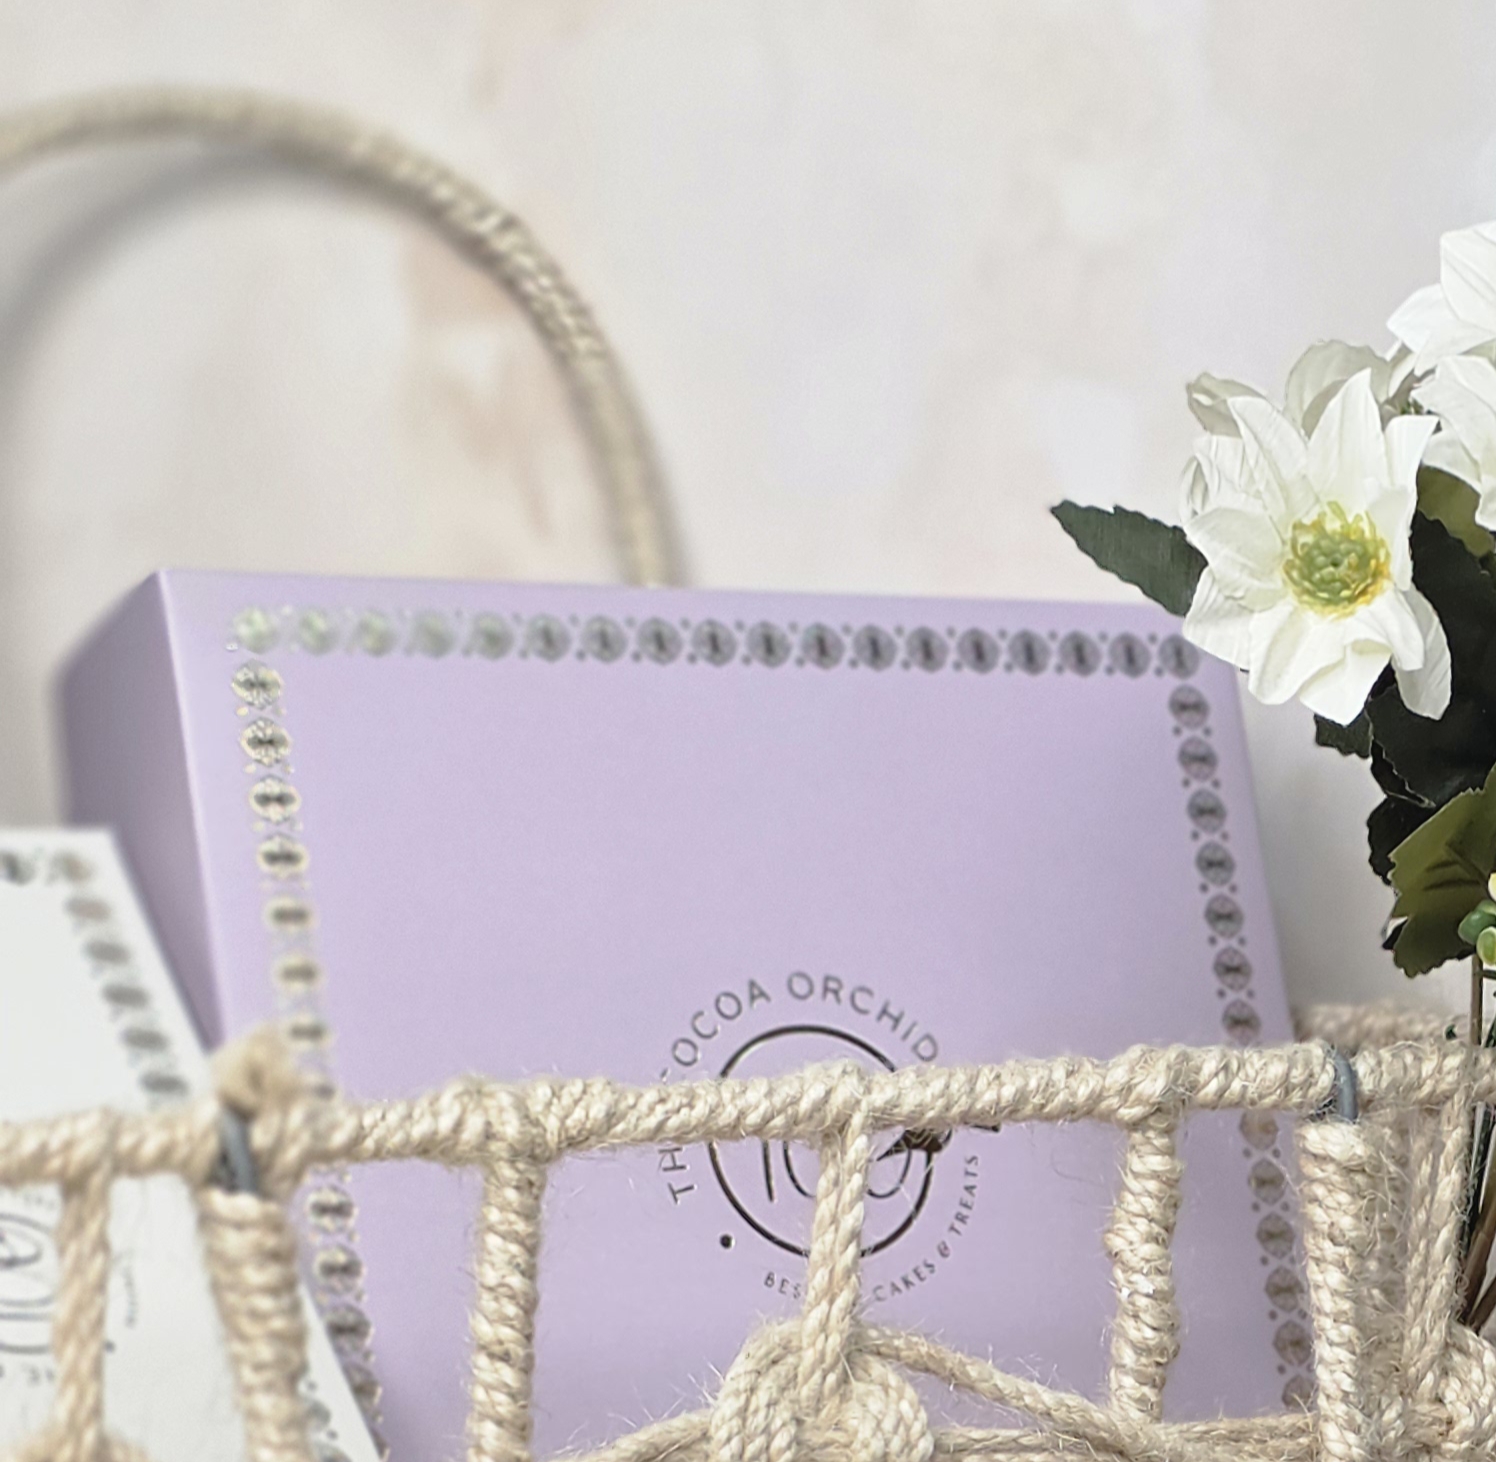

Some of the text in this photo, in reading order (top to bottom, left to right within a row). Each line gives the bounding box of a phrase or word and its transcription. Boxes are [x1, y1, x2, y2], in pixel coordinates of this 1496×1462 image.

[660, 978, 772, 1081] OCOA
[786, 972, 939, 1063] ORCHID
[873, 1154, 980, 1302] CAKES & TREATS
